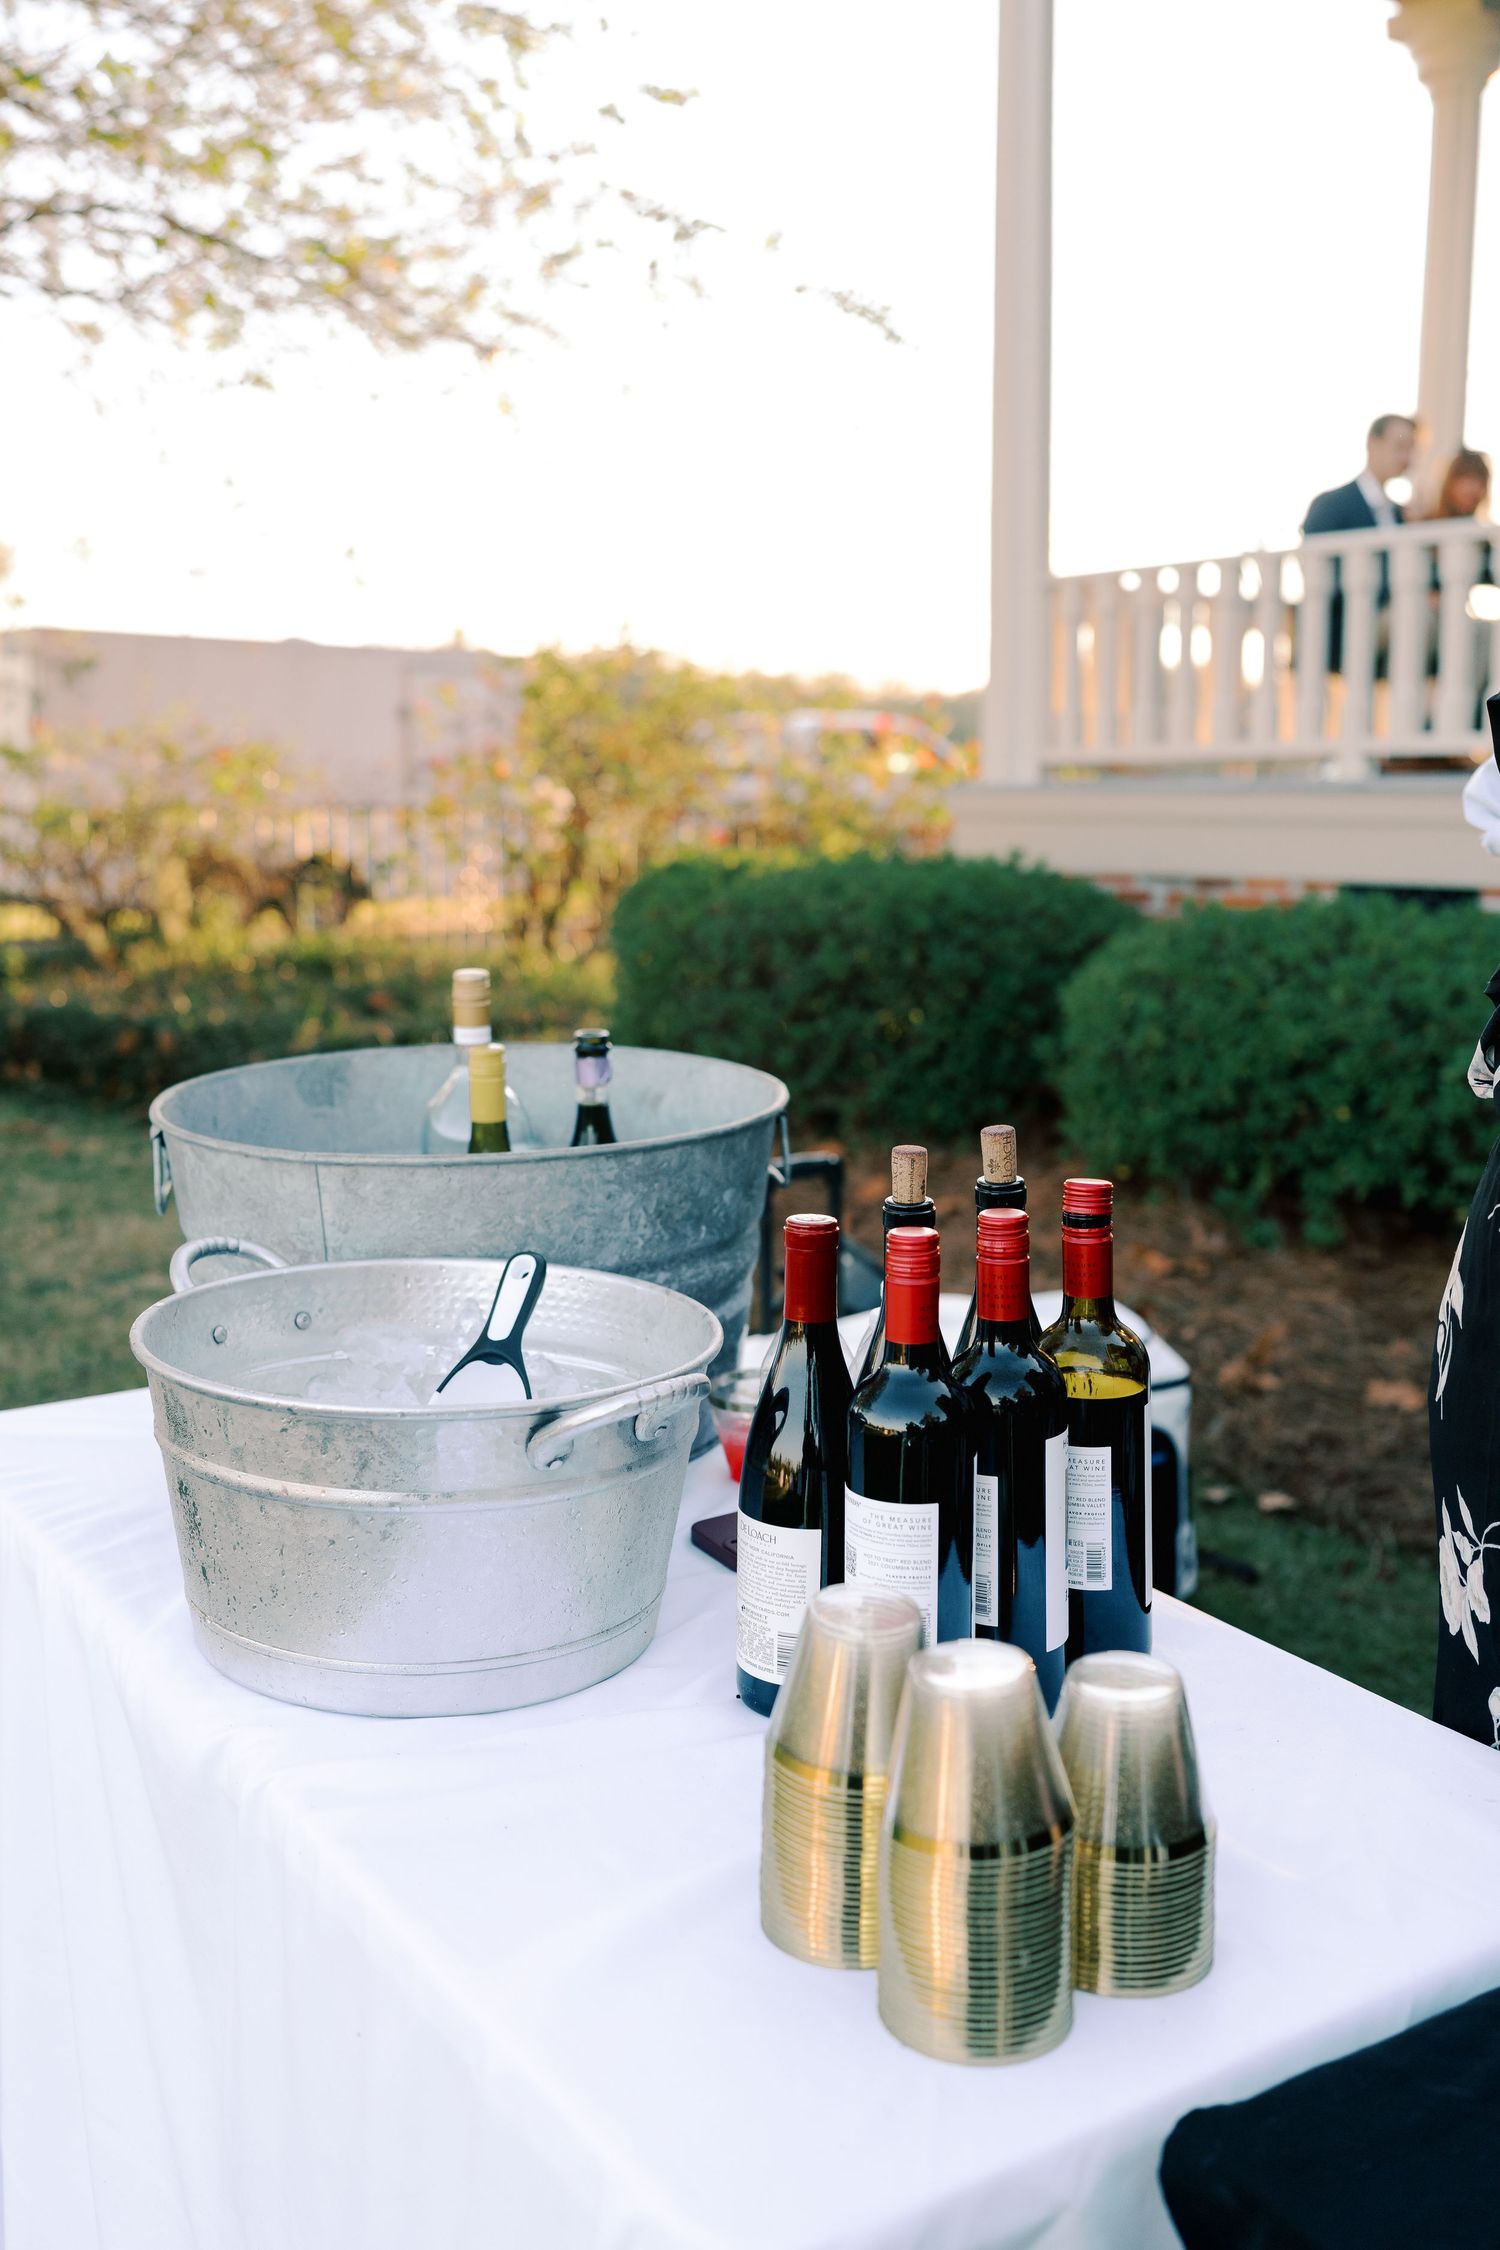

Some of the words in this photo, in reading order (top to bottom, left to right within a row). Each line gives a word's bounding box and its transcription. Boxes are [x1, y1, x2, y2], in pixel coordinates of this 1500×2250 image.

[870, 1512, 884, 1521] THE
[889, 1516, 932, 1524] MEASURE
[876, 1521, 904, 1531] GREAT
[760, 1549, 795, 1560] CALIFORNIA
[881, 1562, 910, 1570] COLUMBIA
